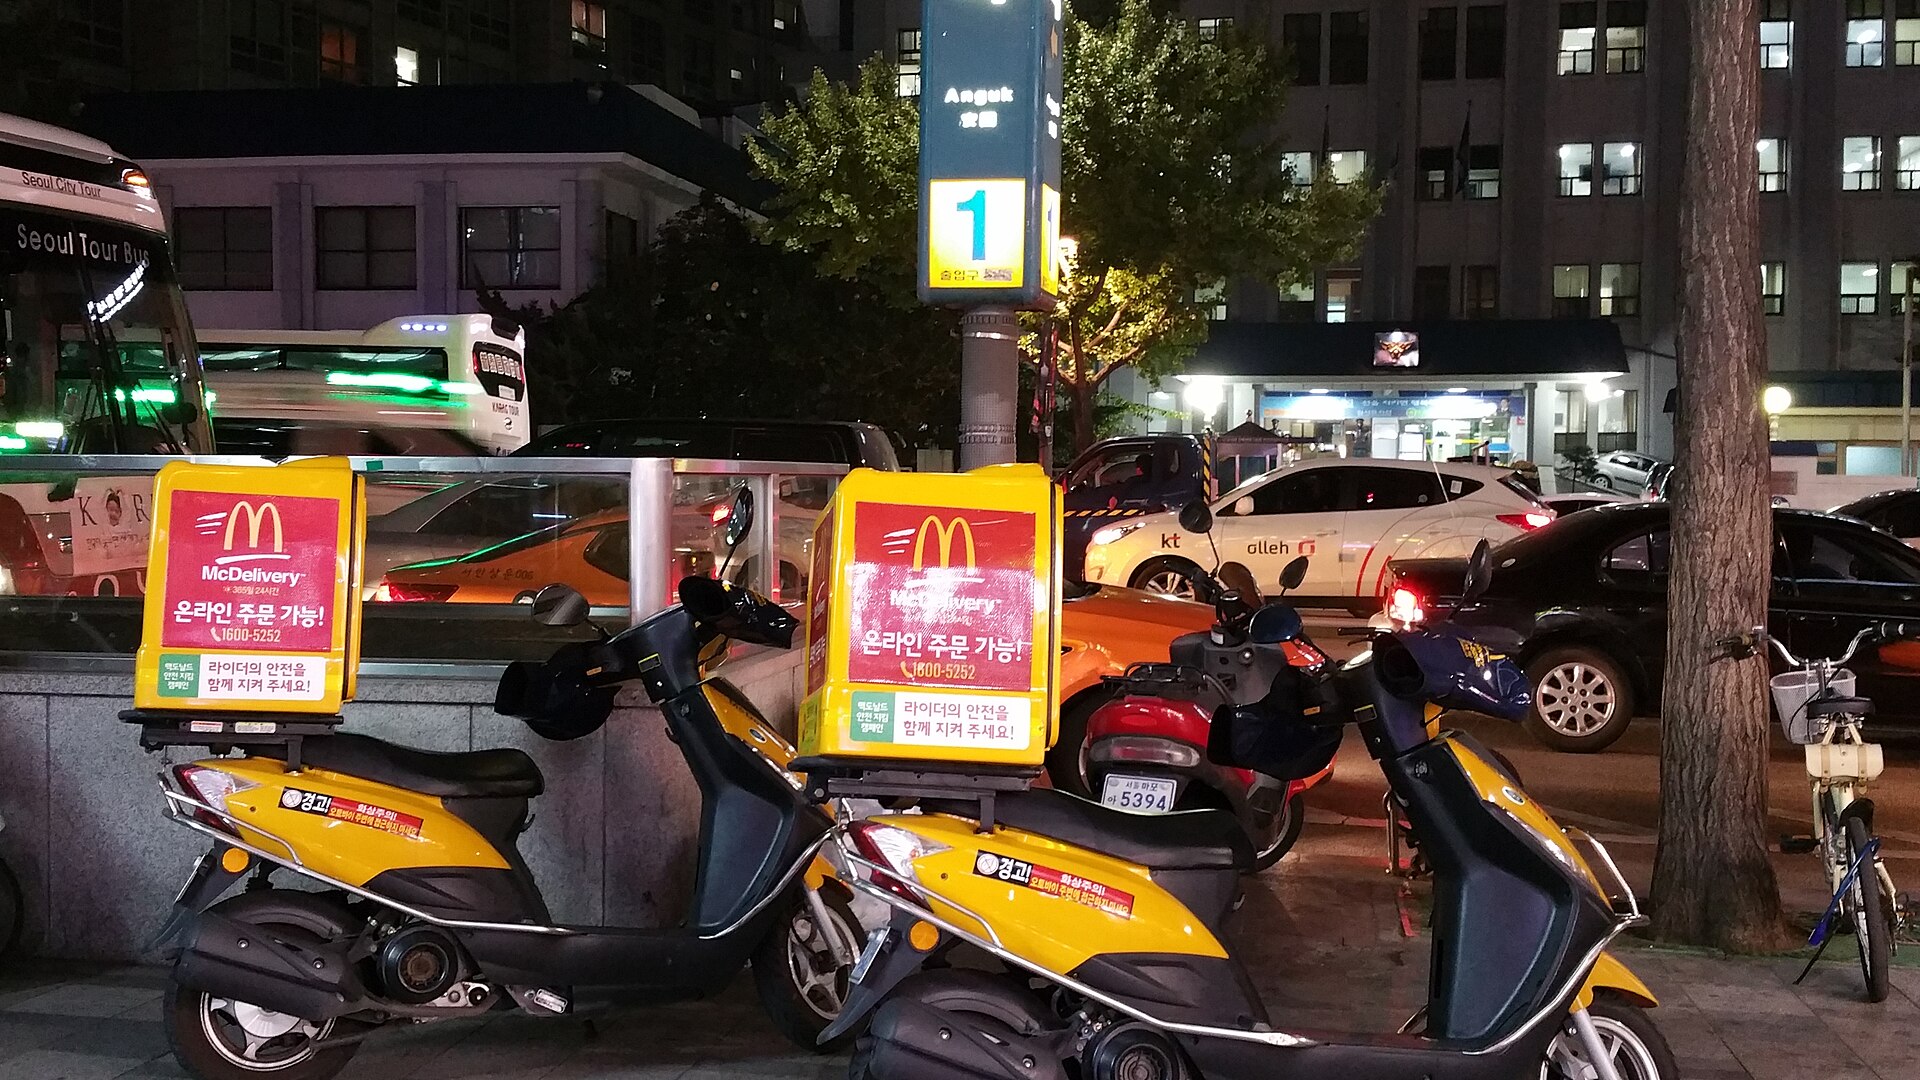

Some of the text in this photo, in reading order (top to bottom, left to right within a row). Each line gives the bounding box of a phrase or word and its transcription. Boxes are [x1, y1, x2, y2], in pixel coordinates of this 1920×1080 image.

[944, 87, 1014, 107] Anguk
[21, 171, 101, 197] Seoul City Tour
[956, 189, 986, 261] 1
[17, 223, 150, 268] Seoul Tour Bus
[1161, 532, 1181, 549] kt
[1247, 540, 1290, 555] olleh
[202, 565, 301, 588] McDelivery
[173, 600, 325, 629] 온라인 주문 가능!
[222, 628, 281, 643] 1600-5252
[862, 629, 1023, 664] 온라인 주문 가능!
[208, 661, 306, 677] 라이더의 안전을
[912, 662, 976, 680] 1600-5252
[207, 678, 311, 693] 함께 지켜 주세요!
[904, 701, 1009, 721] 라이더의 안전을
[904, 720, 1014, 740] 함께 지켜 주세요!
[1141, 782, 1158, 791] 마포
[301, 792, 332, 813] 경고!
[1107, 791, 1167, 811] 아 5394
[356, 803, 398, 821] 화상주의!
[998, 857, 1032, 883] 경고!
[1060, 873, 1106, 896] 화상주의!
